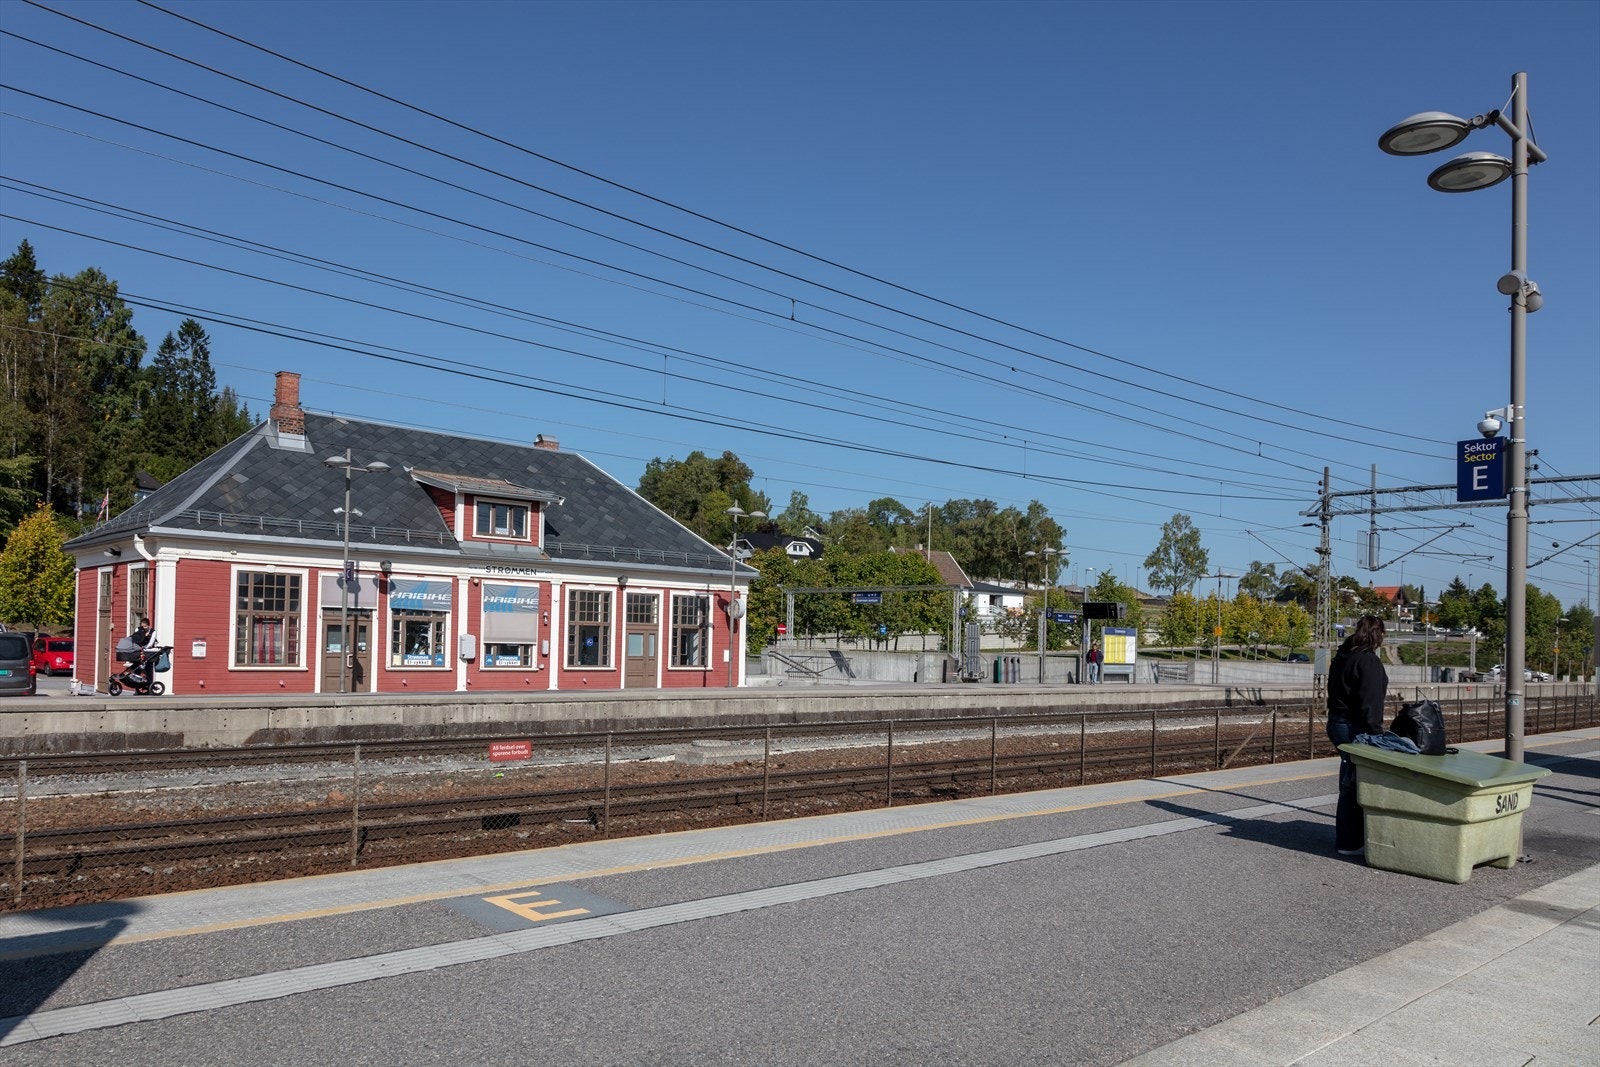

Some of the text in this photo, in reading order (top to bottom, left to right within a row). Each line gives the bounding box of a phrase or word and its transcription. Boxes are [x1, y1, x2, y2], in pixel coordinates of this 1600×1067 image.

[1464, 442, 1497, 453] Sektor
[1464, 452, 1497, 463] Sector
[1472, 465, 1489, 491] E
[485, 565, 537, 576] STRØMMEN
[390, 591, 452, 601] HAIBIKE
[483, 595, 539, 605] HAIBIKE
[1495, 793, 1519, 814] SAND
[481, 891, 592, 922] E
